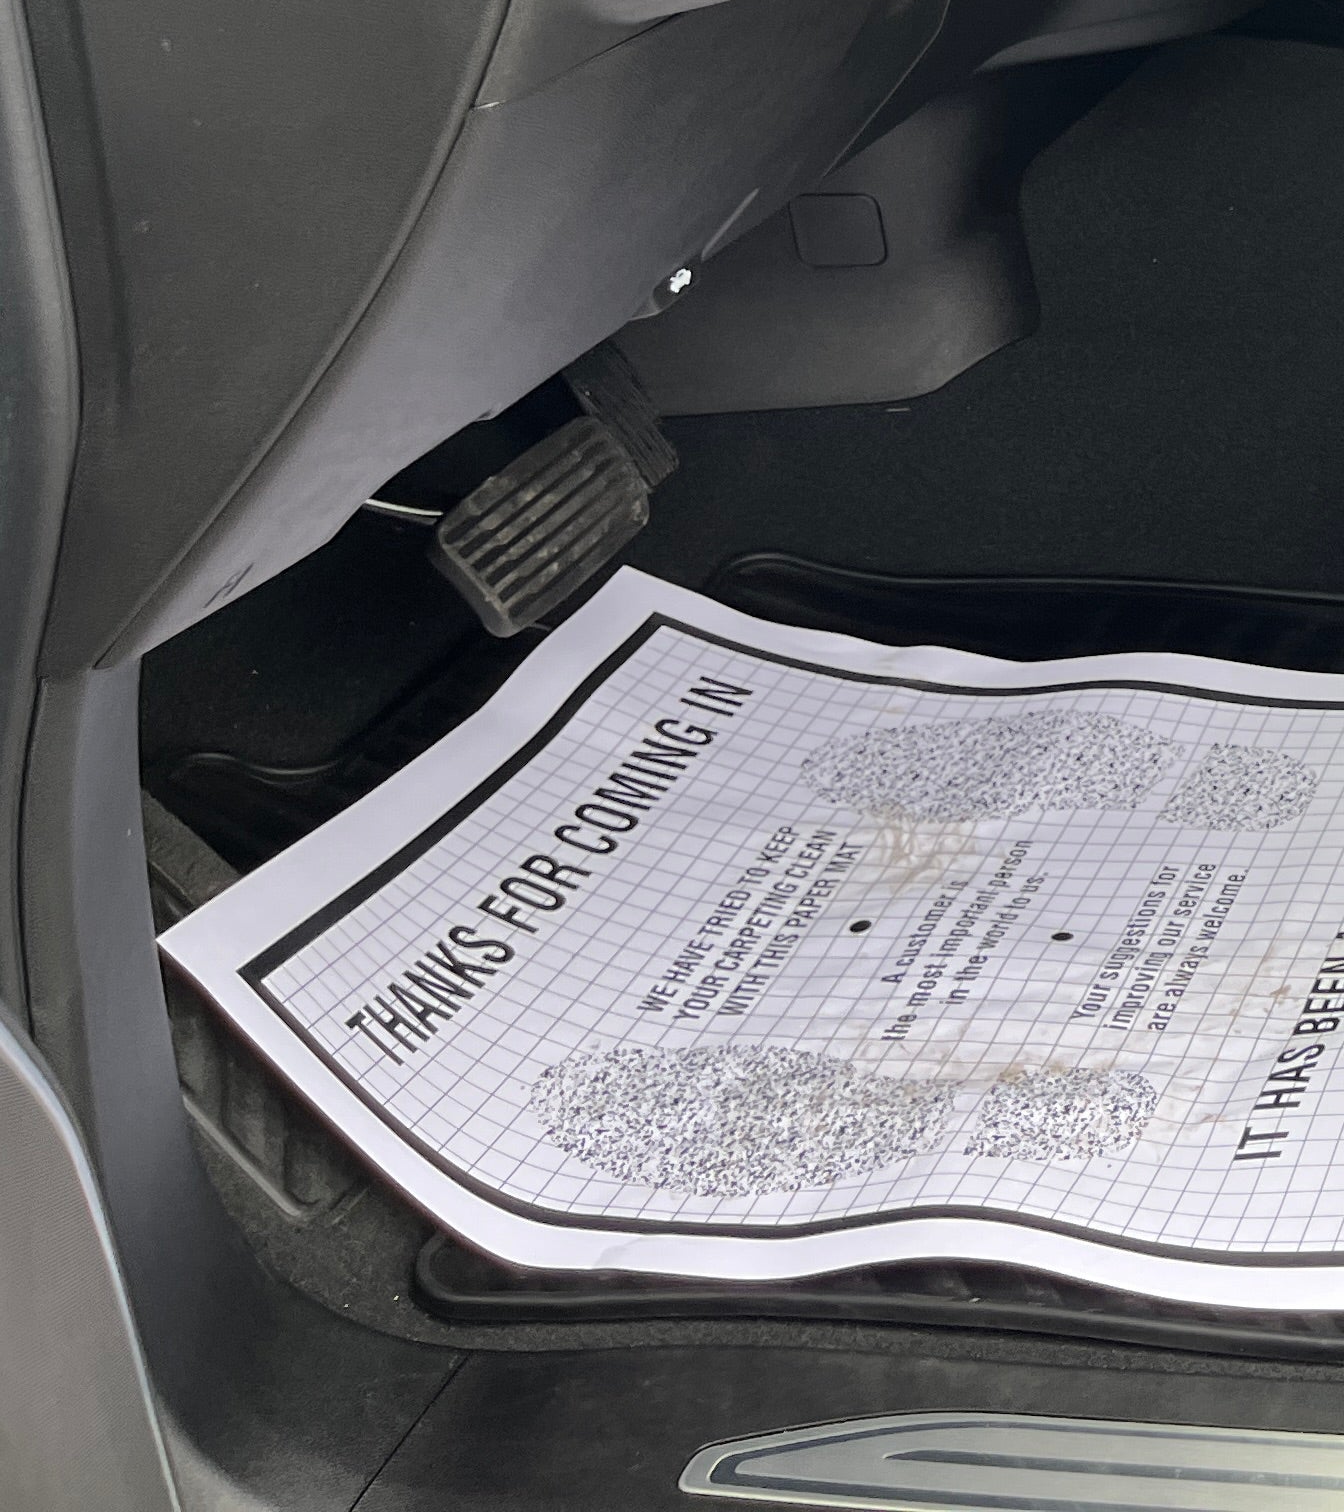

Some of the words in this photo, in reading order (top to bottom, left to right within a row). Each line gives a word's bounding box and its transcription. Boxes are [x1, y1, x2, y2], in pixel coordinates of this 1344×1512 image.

[344, 925, 516, 1067] THANKS
[476, 854, 593, 934] FOR
[554, 718, 719, 854] COMING
[680, 676, 754, 717] IN
[636, 984, 679, 1013] WE
[661, 939, 715, 983] HAVE
[697, 889, 752, 936] TRIED
[737, 867, 770, 885] TO
[756, 826, 800, 864] KEEP
[672, 974, 730, 1020] YOUR
[714, 881, 799, 971] CARPETING
[785, 830, 838, 879] CLEAN
[716, 972, 770, 1016] WITH
[753, 933, 799, 968] THIS
[785, 878, 841, 928] PAPER
[824, 841, 865, 873] MAT
[881, 971, 907, 984] A
[896, 893, 957, 967] customer
[941, 880, 969, 891] is
[976, 912, 1019, 950] world
[1003, 897, 1031, 909] to
[1020, 872, 1049, 893] us.
[880, 1014, 918, 1041] the
[906, 963, 948, 1007] most
[929, 890, 1000, 958] important
[987, 840, 1034, 888] person
[938, 989, 970, 1005] in
[953, 955, 989, 981] the
[1069, 983, 1111, 1019] Your
[1100, 891, 1166, 980] suggestions
[1150, 865, 1180, 886] for
[1102, 952, 1174, 1030] improving
[1157, 921, 1185, 946] our
[1173, 863, 1216, 917] service
[1147, 1002, 1176, 1031] are
[1164, 945, 1209, 997] always
[1195, 869, 1249, 940] welcome.
[1253, 1043, 1326, 1110] HAS
[1233, 1126, 1290, 1161] IT
